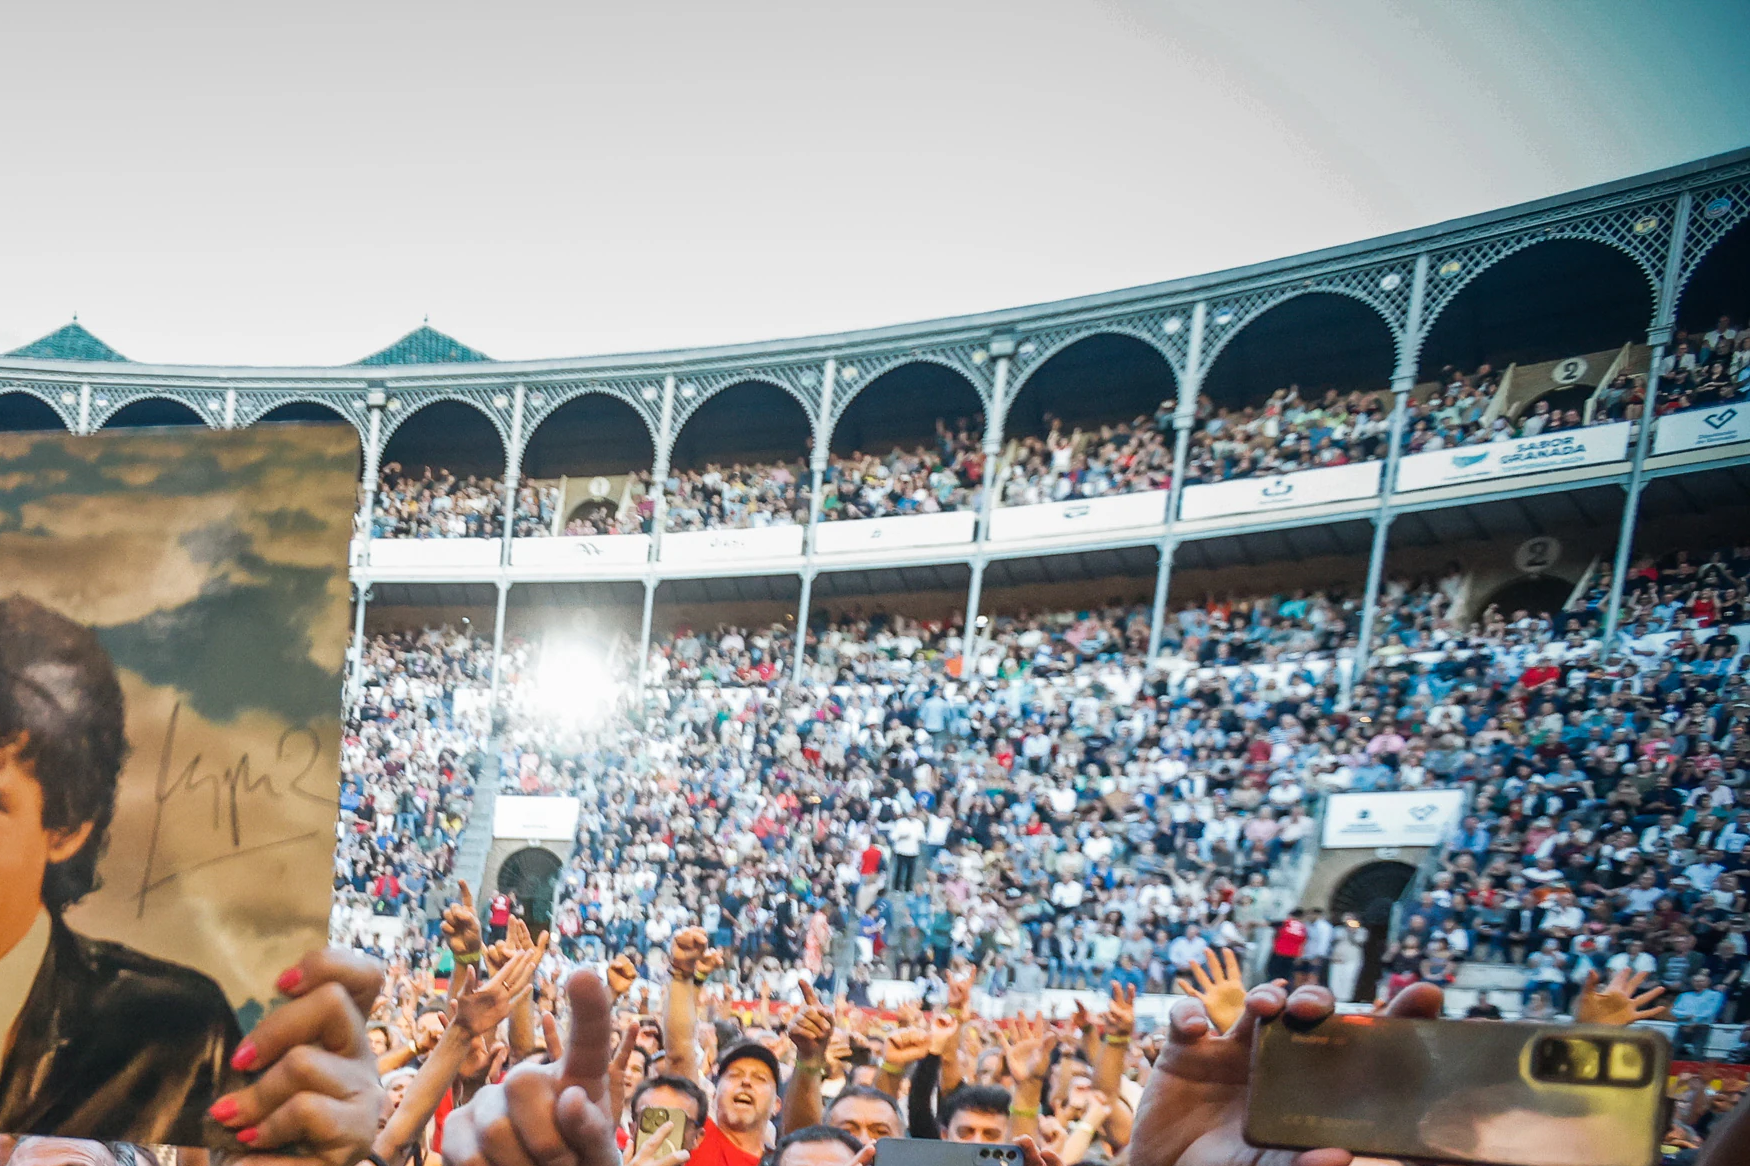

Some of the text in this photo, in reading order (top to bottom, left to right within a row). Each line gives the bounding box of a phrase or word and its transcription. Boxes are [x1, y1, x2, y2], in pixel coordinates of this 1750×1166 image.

[1562, 361, 1579, 381] 2
[1499, 443, 1587, 465] GRANADA
[1515, 436, 1575, 453] SABOR
[1526, 541, 1545, 567] 2
